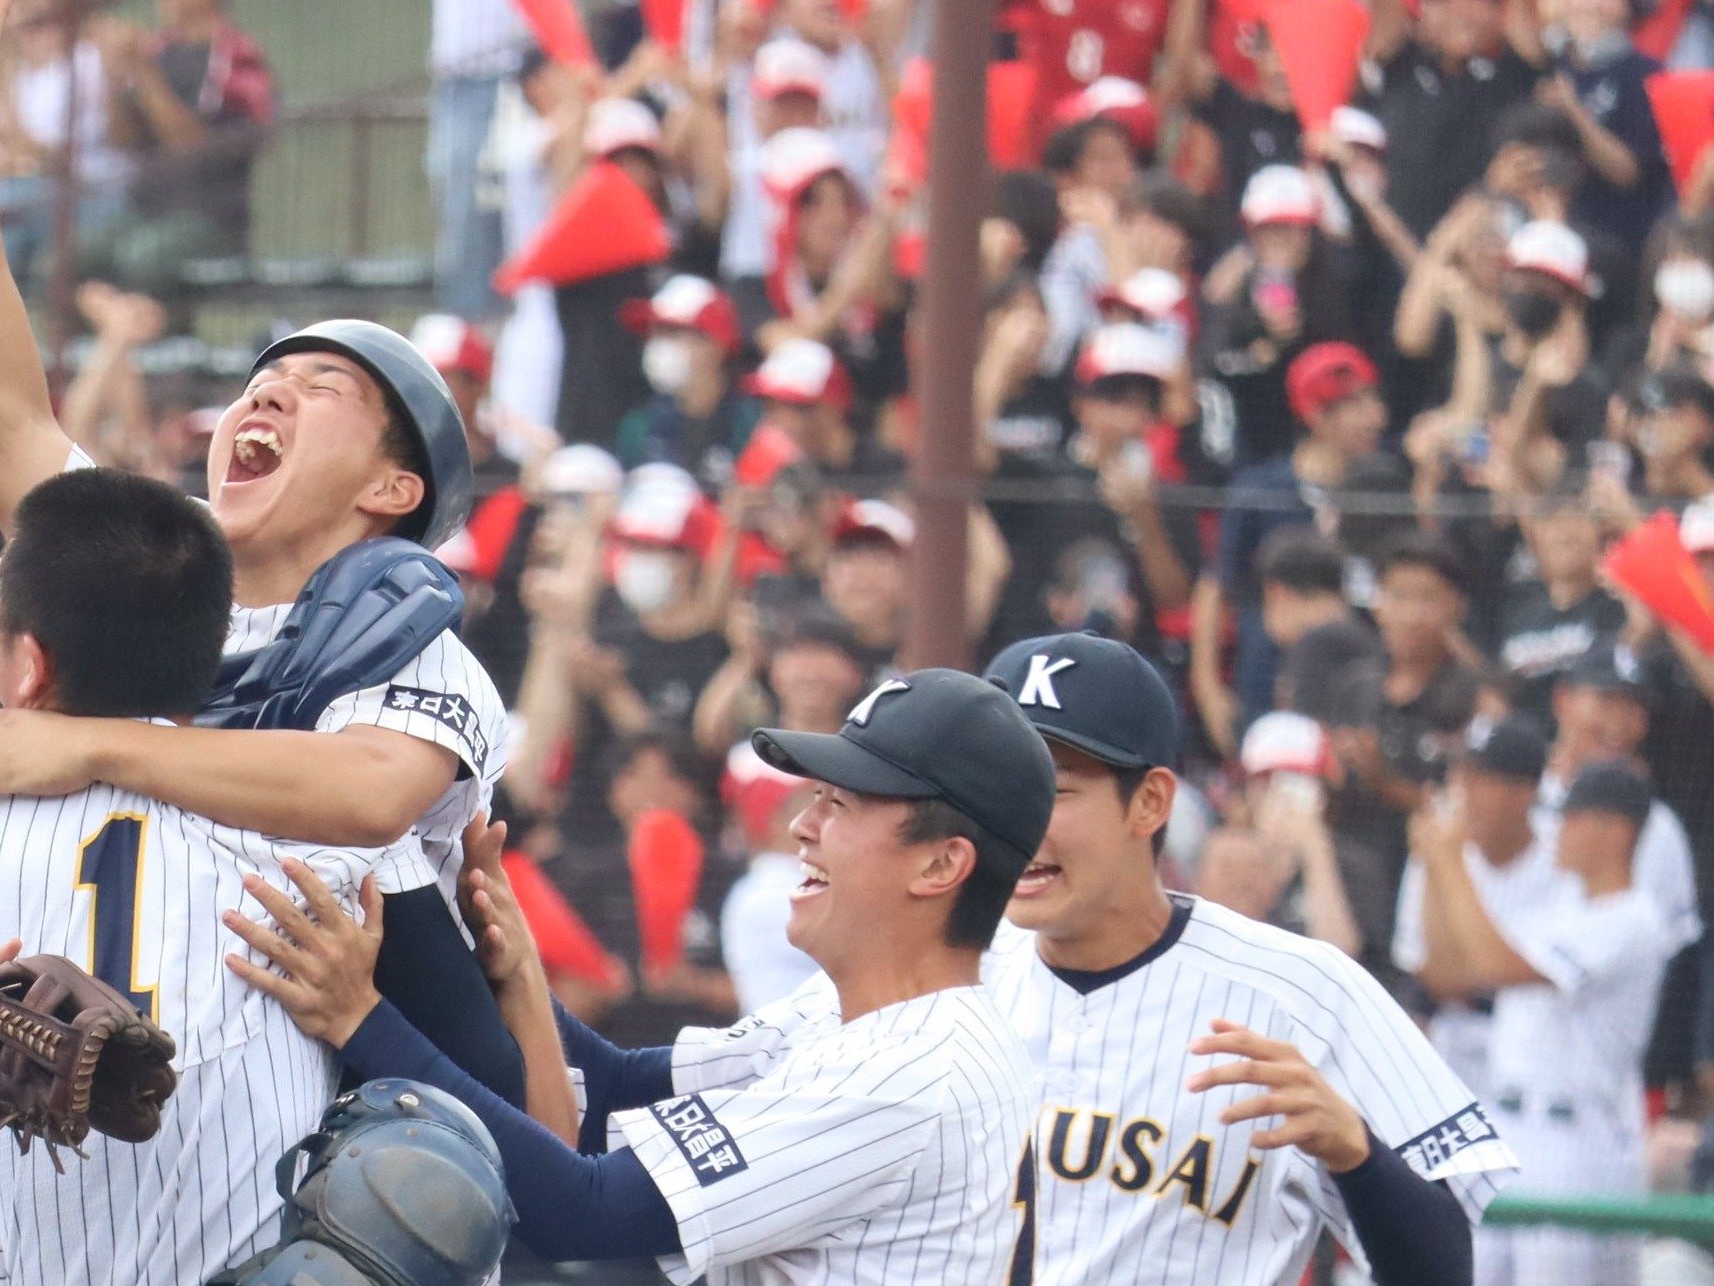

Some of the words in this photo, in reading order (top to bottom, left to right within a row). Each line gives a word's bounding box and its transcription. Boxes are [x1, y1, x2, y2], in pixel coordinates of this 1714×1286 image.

[846, 678, 911, 727] K
[1018, 654, 1077, 710] K
[72, 810, 160, 1027] 1
[1041, 1102, 1264, 1231] USAI
